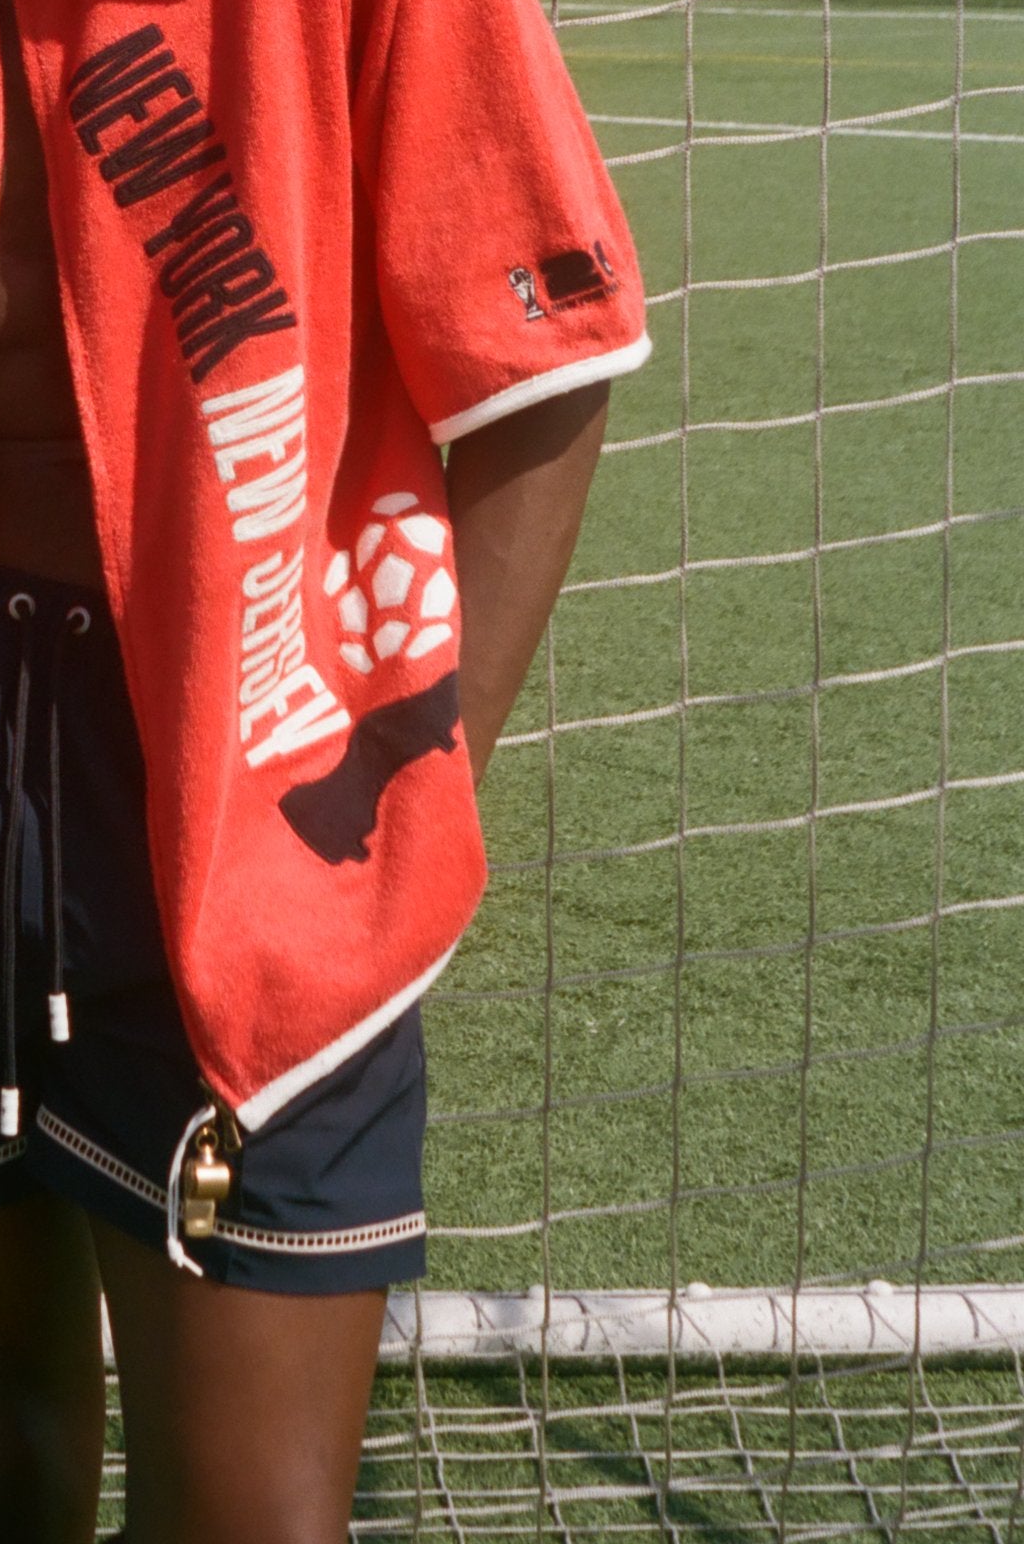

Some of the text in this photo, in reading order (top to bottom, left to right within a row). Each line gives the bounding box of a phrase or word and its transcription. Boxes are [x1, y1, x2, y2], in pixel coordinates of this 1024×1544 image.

[69, 23, 352, 768] NEW YORK NEW JERSEY
